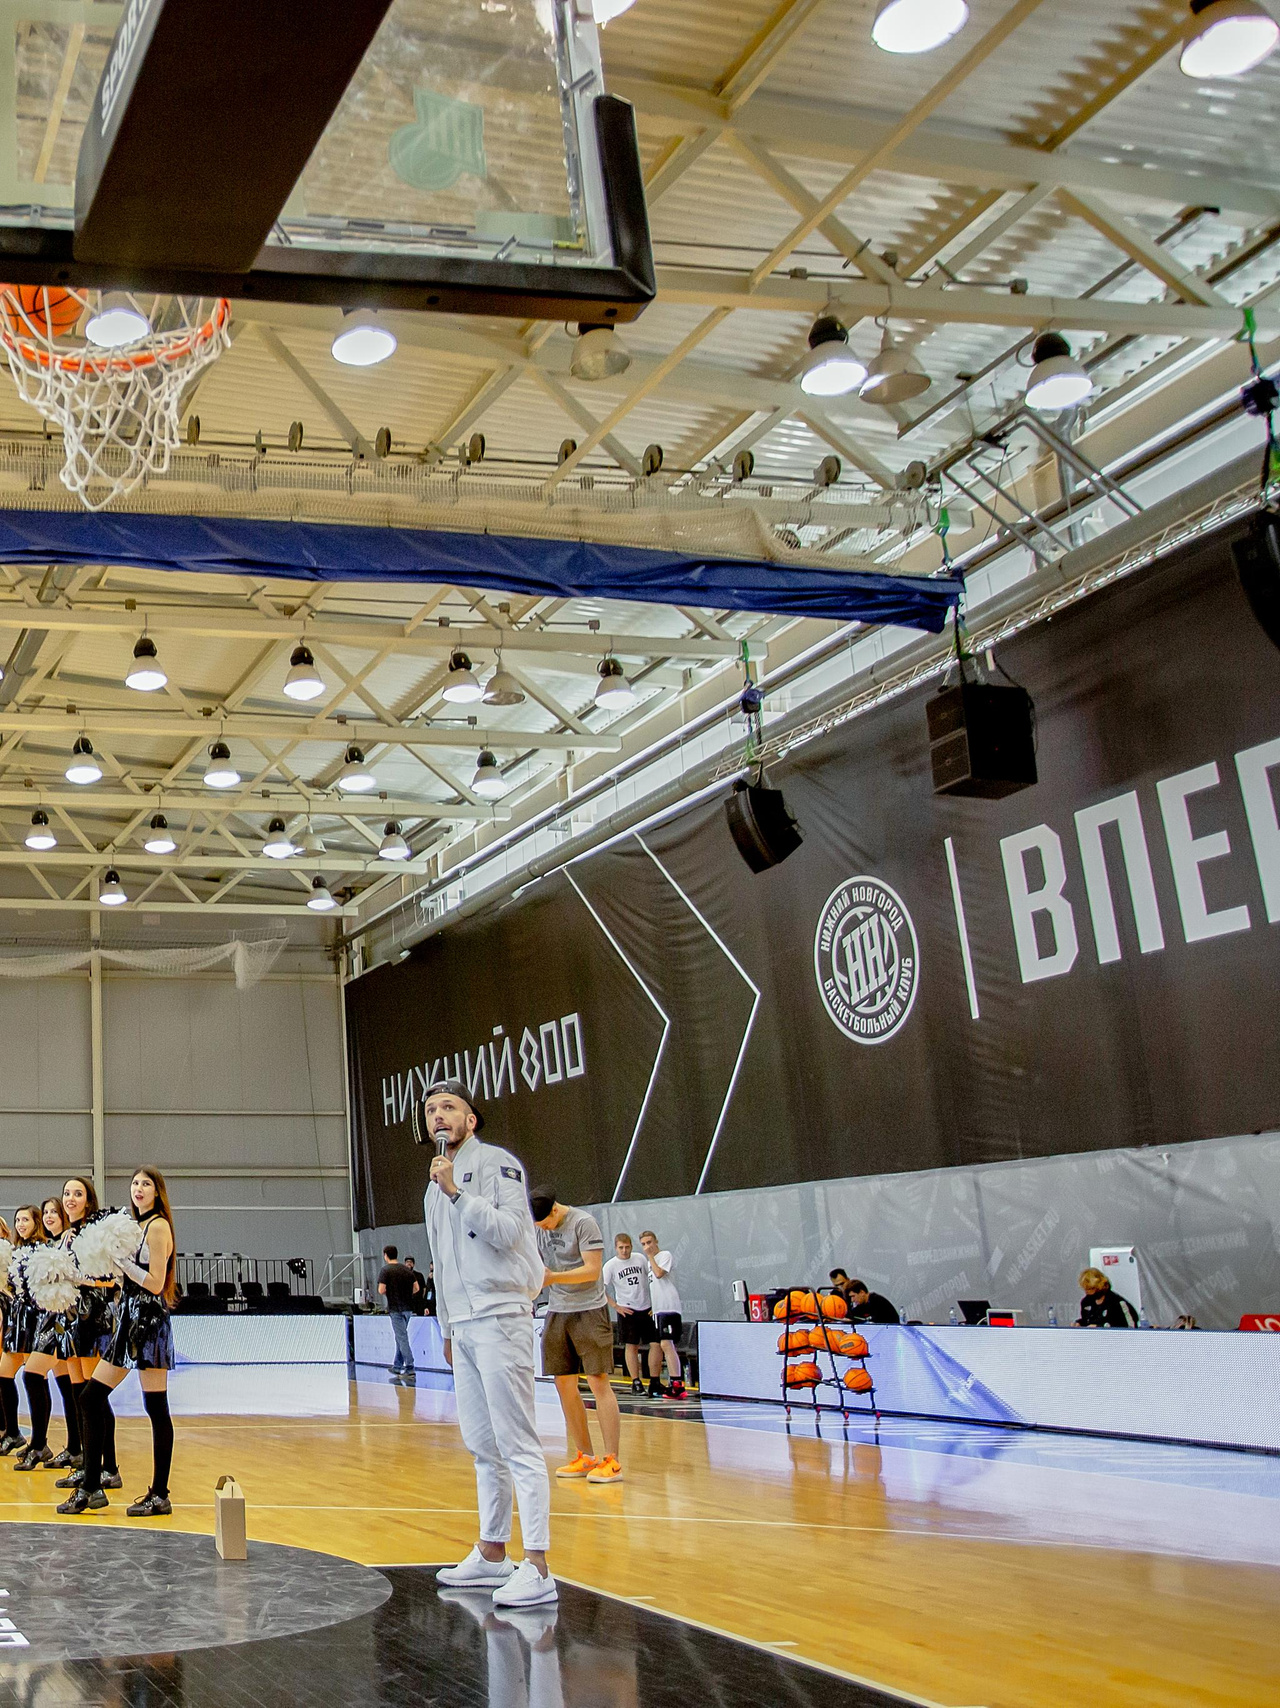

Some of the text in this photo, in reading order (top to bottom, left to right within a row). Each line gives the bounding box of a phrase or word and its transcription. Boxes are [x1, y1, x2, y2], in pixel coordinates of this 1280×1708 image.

[101, 0, 143, 120] SPOR
[820, 885, 905, 953] НИЖНИЙ НОВГОРОД
[823, 956, 913, 1034] БАСКЕТБОЛЬНЫЙ КЛУБ
[517, 1012, 586, 1093] 800
[617, 1265, 643, 1280] NIZHNY
[627, 1276, 640, 1286] 52
[751, 1299, 760, 1320] 5
